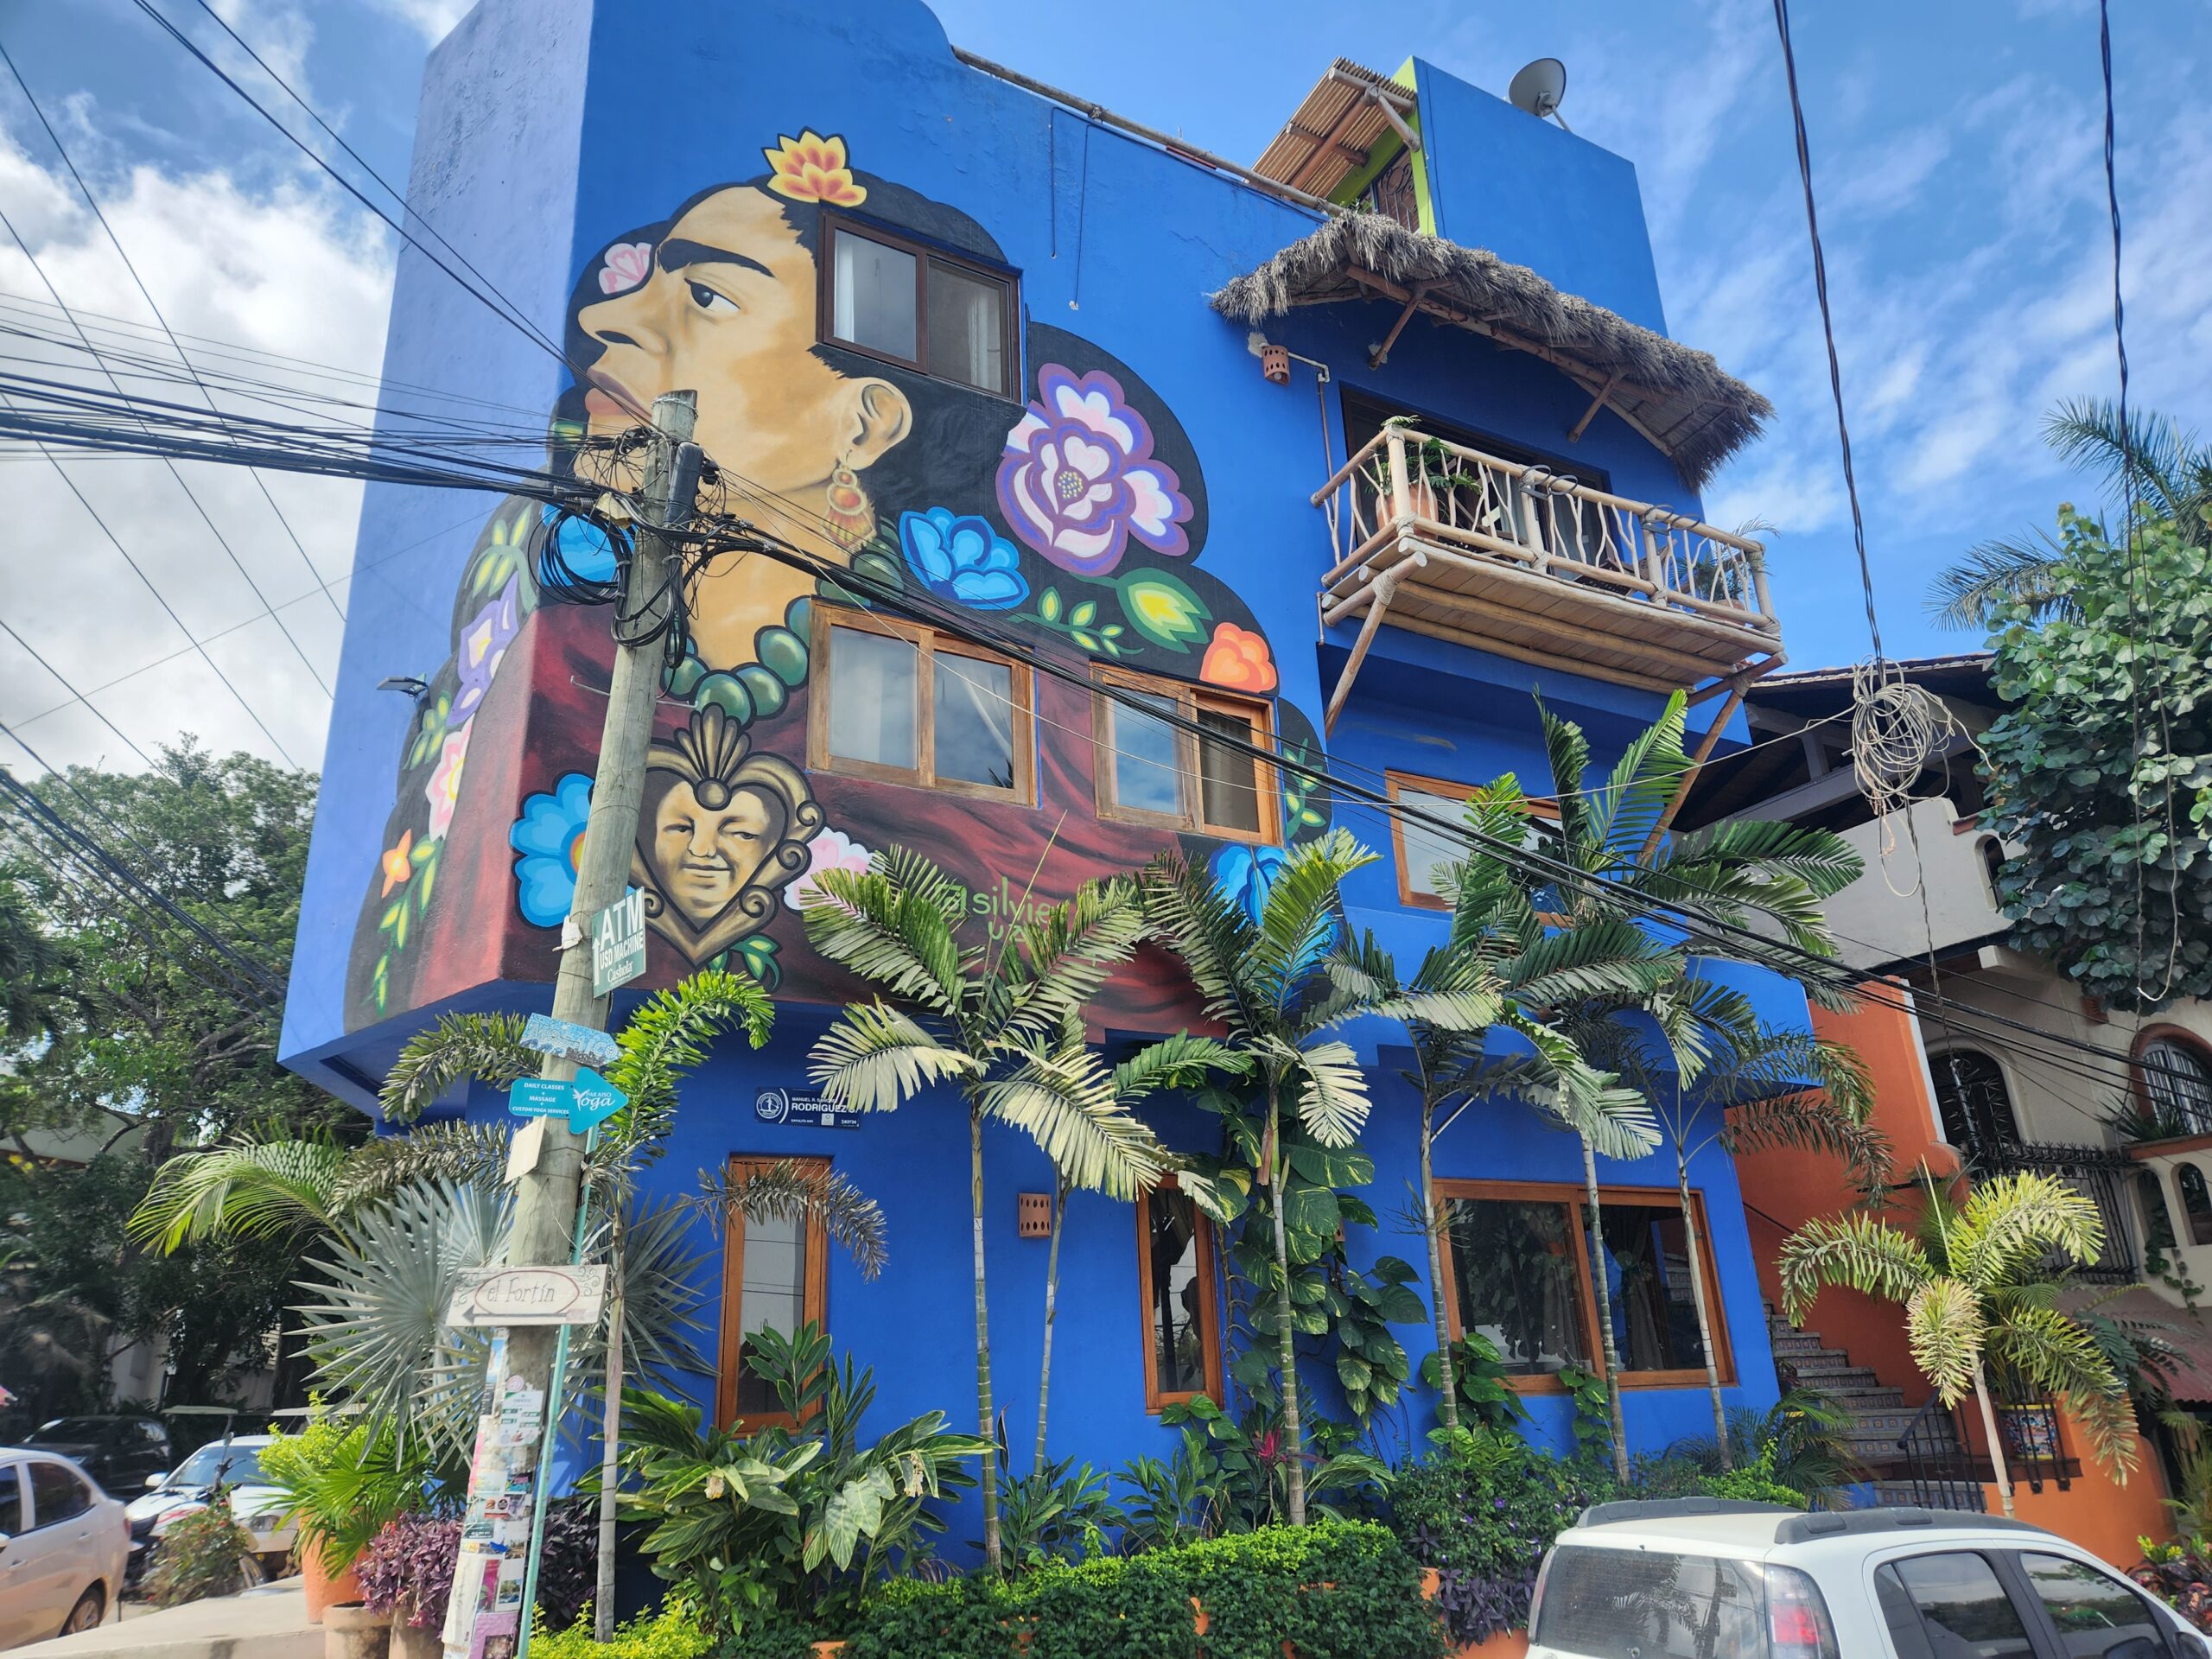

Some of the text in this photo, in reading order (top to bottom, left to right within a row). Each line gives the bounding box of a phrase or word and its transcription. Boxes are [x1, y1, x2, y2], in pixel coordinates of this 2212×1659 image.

[972, 876, 1052, 924] silvie
[600, 888, 643, 952] ATM
[600, 931, 644, 970] USD MACHINE
[607, 960, 633, 982] Cashola
[573, 1089, 615, 1111] Yoga
[487, 1277, 555, 1304] el Fortín
